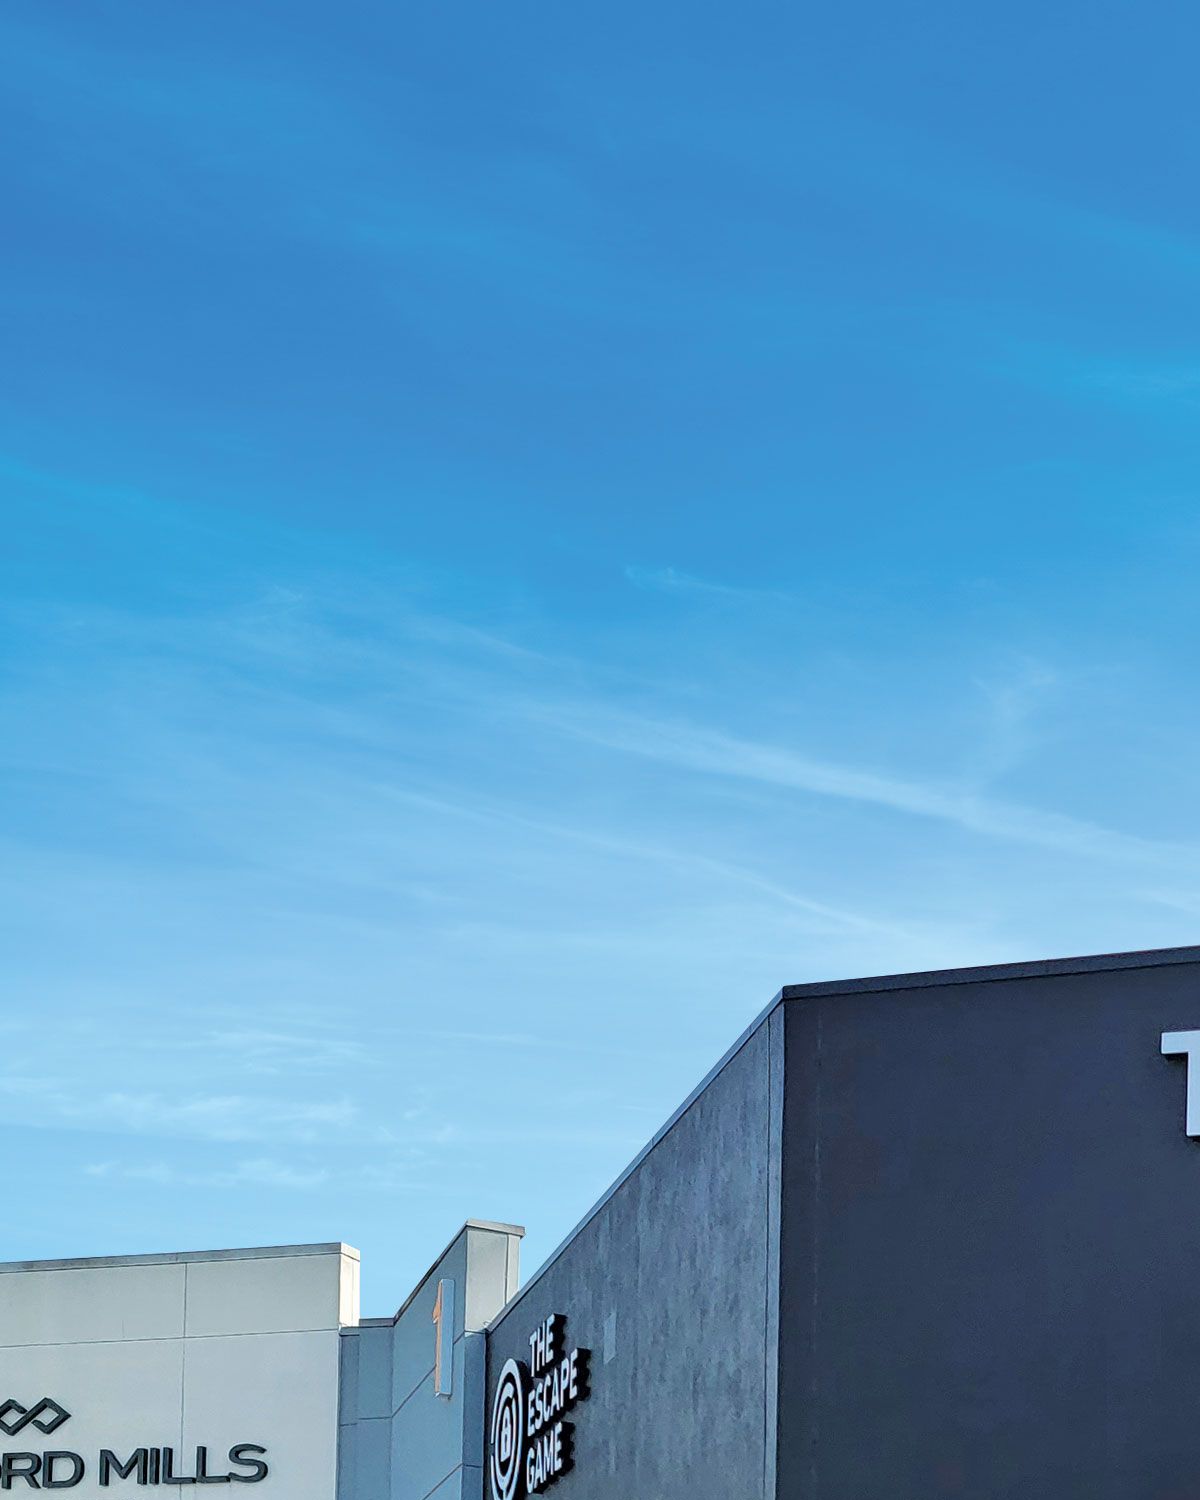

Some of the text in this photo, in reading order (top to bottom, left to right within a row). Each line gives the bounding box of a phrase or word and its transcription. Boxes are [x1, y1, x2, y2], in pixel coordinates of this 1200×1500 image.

[529, 1313, 556, 1378] THE
[527, 1348, 579, 1437] ESCAPE
[0, 1443, 269, 1490] RD MILLS
[526, 1421, 563, 1494] GAME
